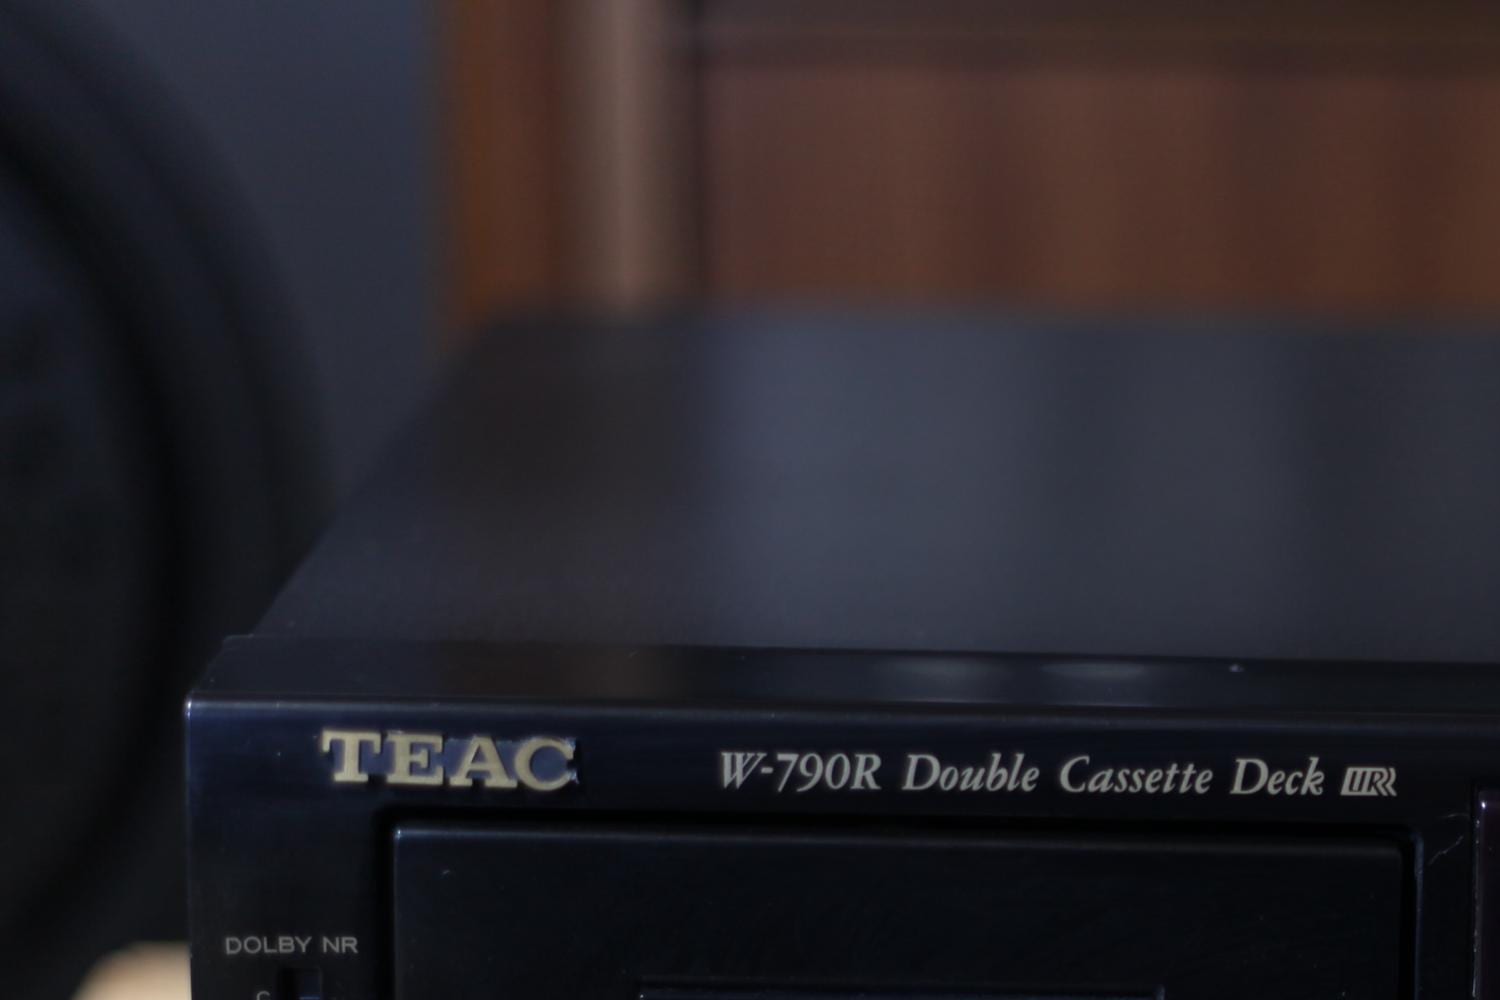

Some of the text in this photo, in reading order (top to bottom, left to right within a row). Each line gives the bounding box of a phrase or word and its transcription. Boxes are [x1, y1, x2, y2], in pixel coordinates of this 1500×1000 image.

[322, 729, 577, 791] TEAC
[721, 751, 882, 792] W-790R
[902, 753, 1040, 792] Double
[1059, 755, 1213, 794] Cassette
[1230, 757, 1325, 796] Deck
[225, 936, 359, 955] DOLBY NR
